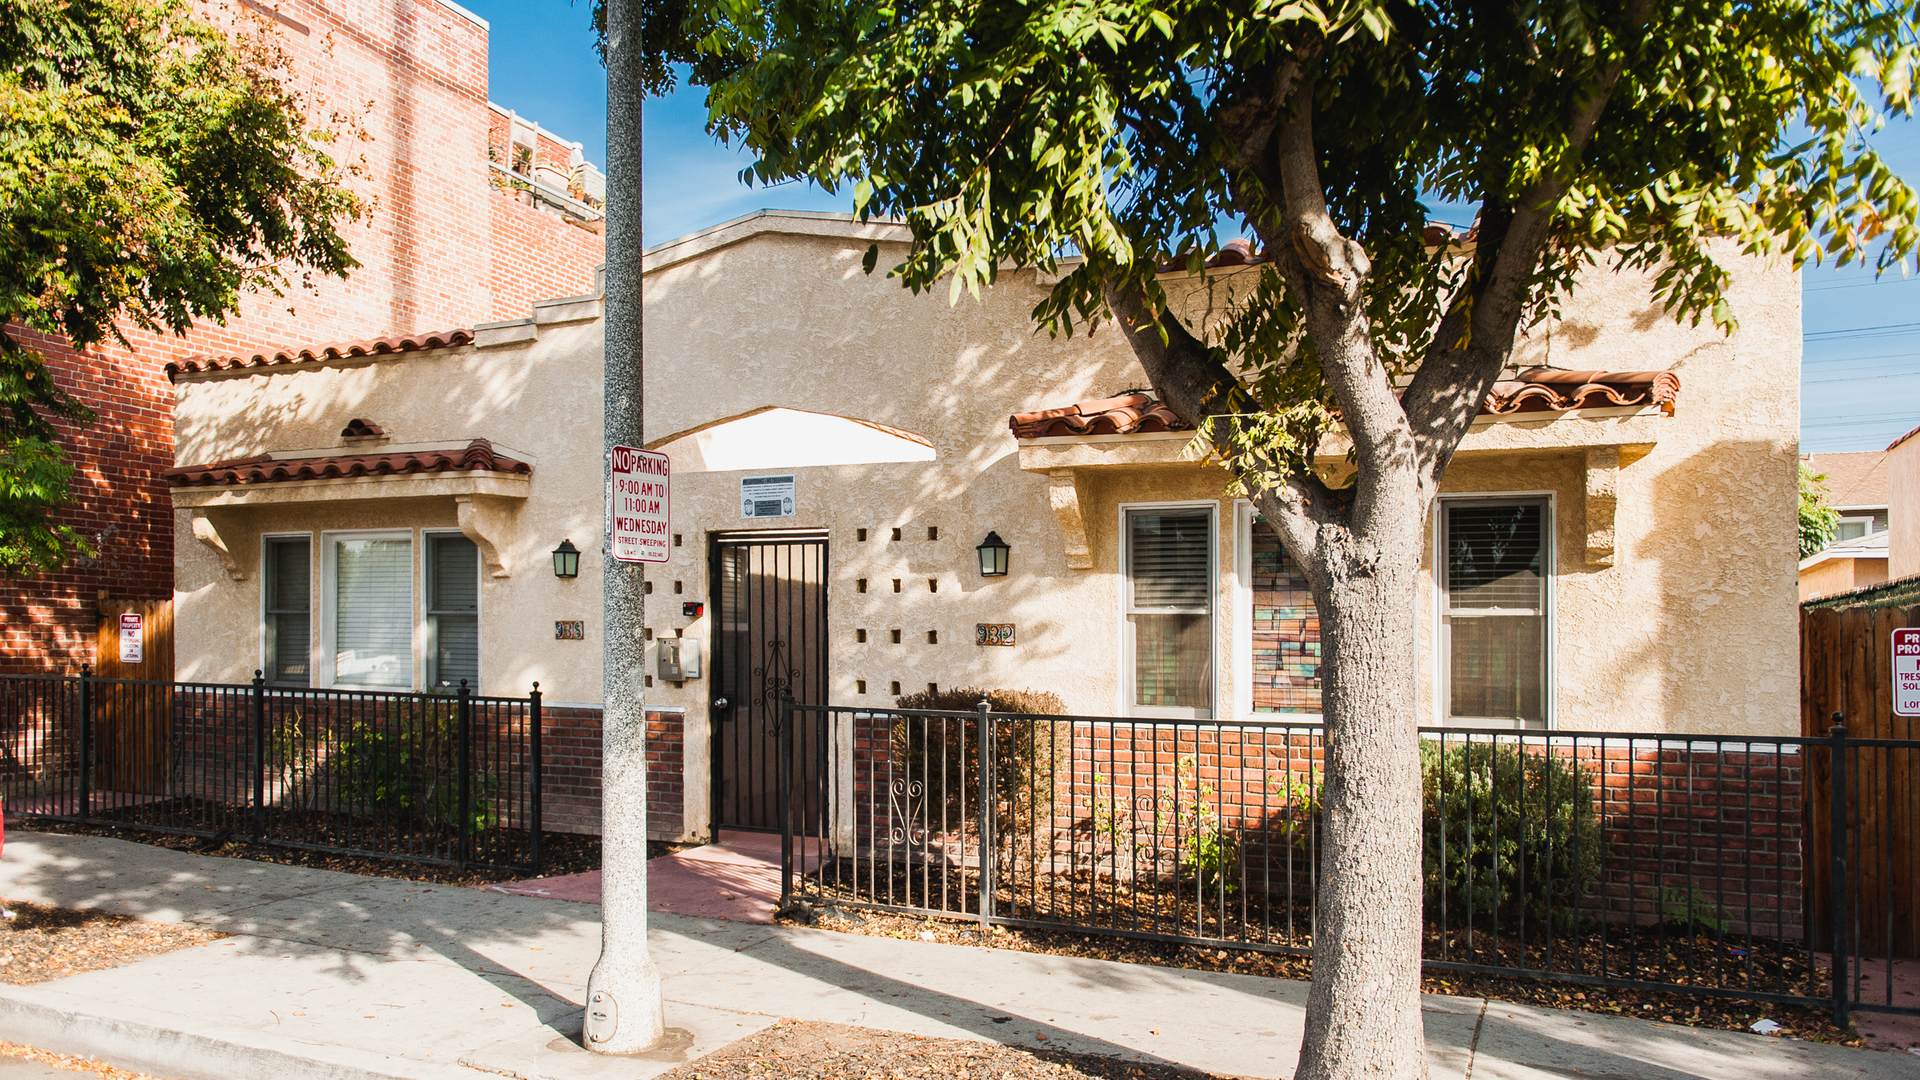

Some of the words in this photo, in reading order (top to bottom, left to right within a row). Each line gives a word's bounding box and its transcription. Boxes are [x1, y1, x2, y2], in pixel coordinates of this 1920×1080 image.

[614, 450, 630, 471] NO
[631, 455, 667, 477] PARKING
[619, 479, 639, 495] 9:00
[641, 482, 653, 497] AM
[654, 484, 664, 498] TO
[624, 497, 646, 513] 11:00
[648, 500, 660, 514] AM
[616, 516, 667, 535] WEDNESDAY
[618, 536, 638, 545] STREET
[639, 539, 666, 548] SWEEPING
[977, 625, 1013, 644] 932
[1904, 633, 1920, 644] PR
[1897, 644, 1920, 654] PRO
[1902, 682, 1920, 691] SOL
